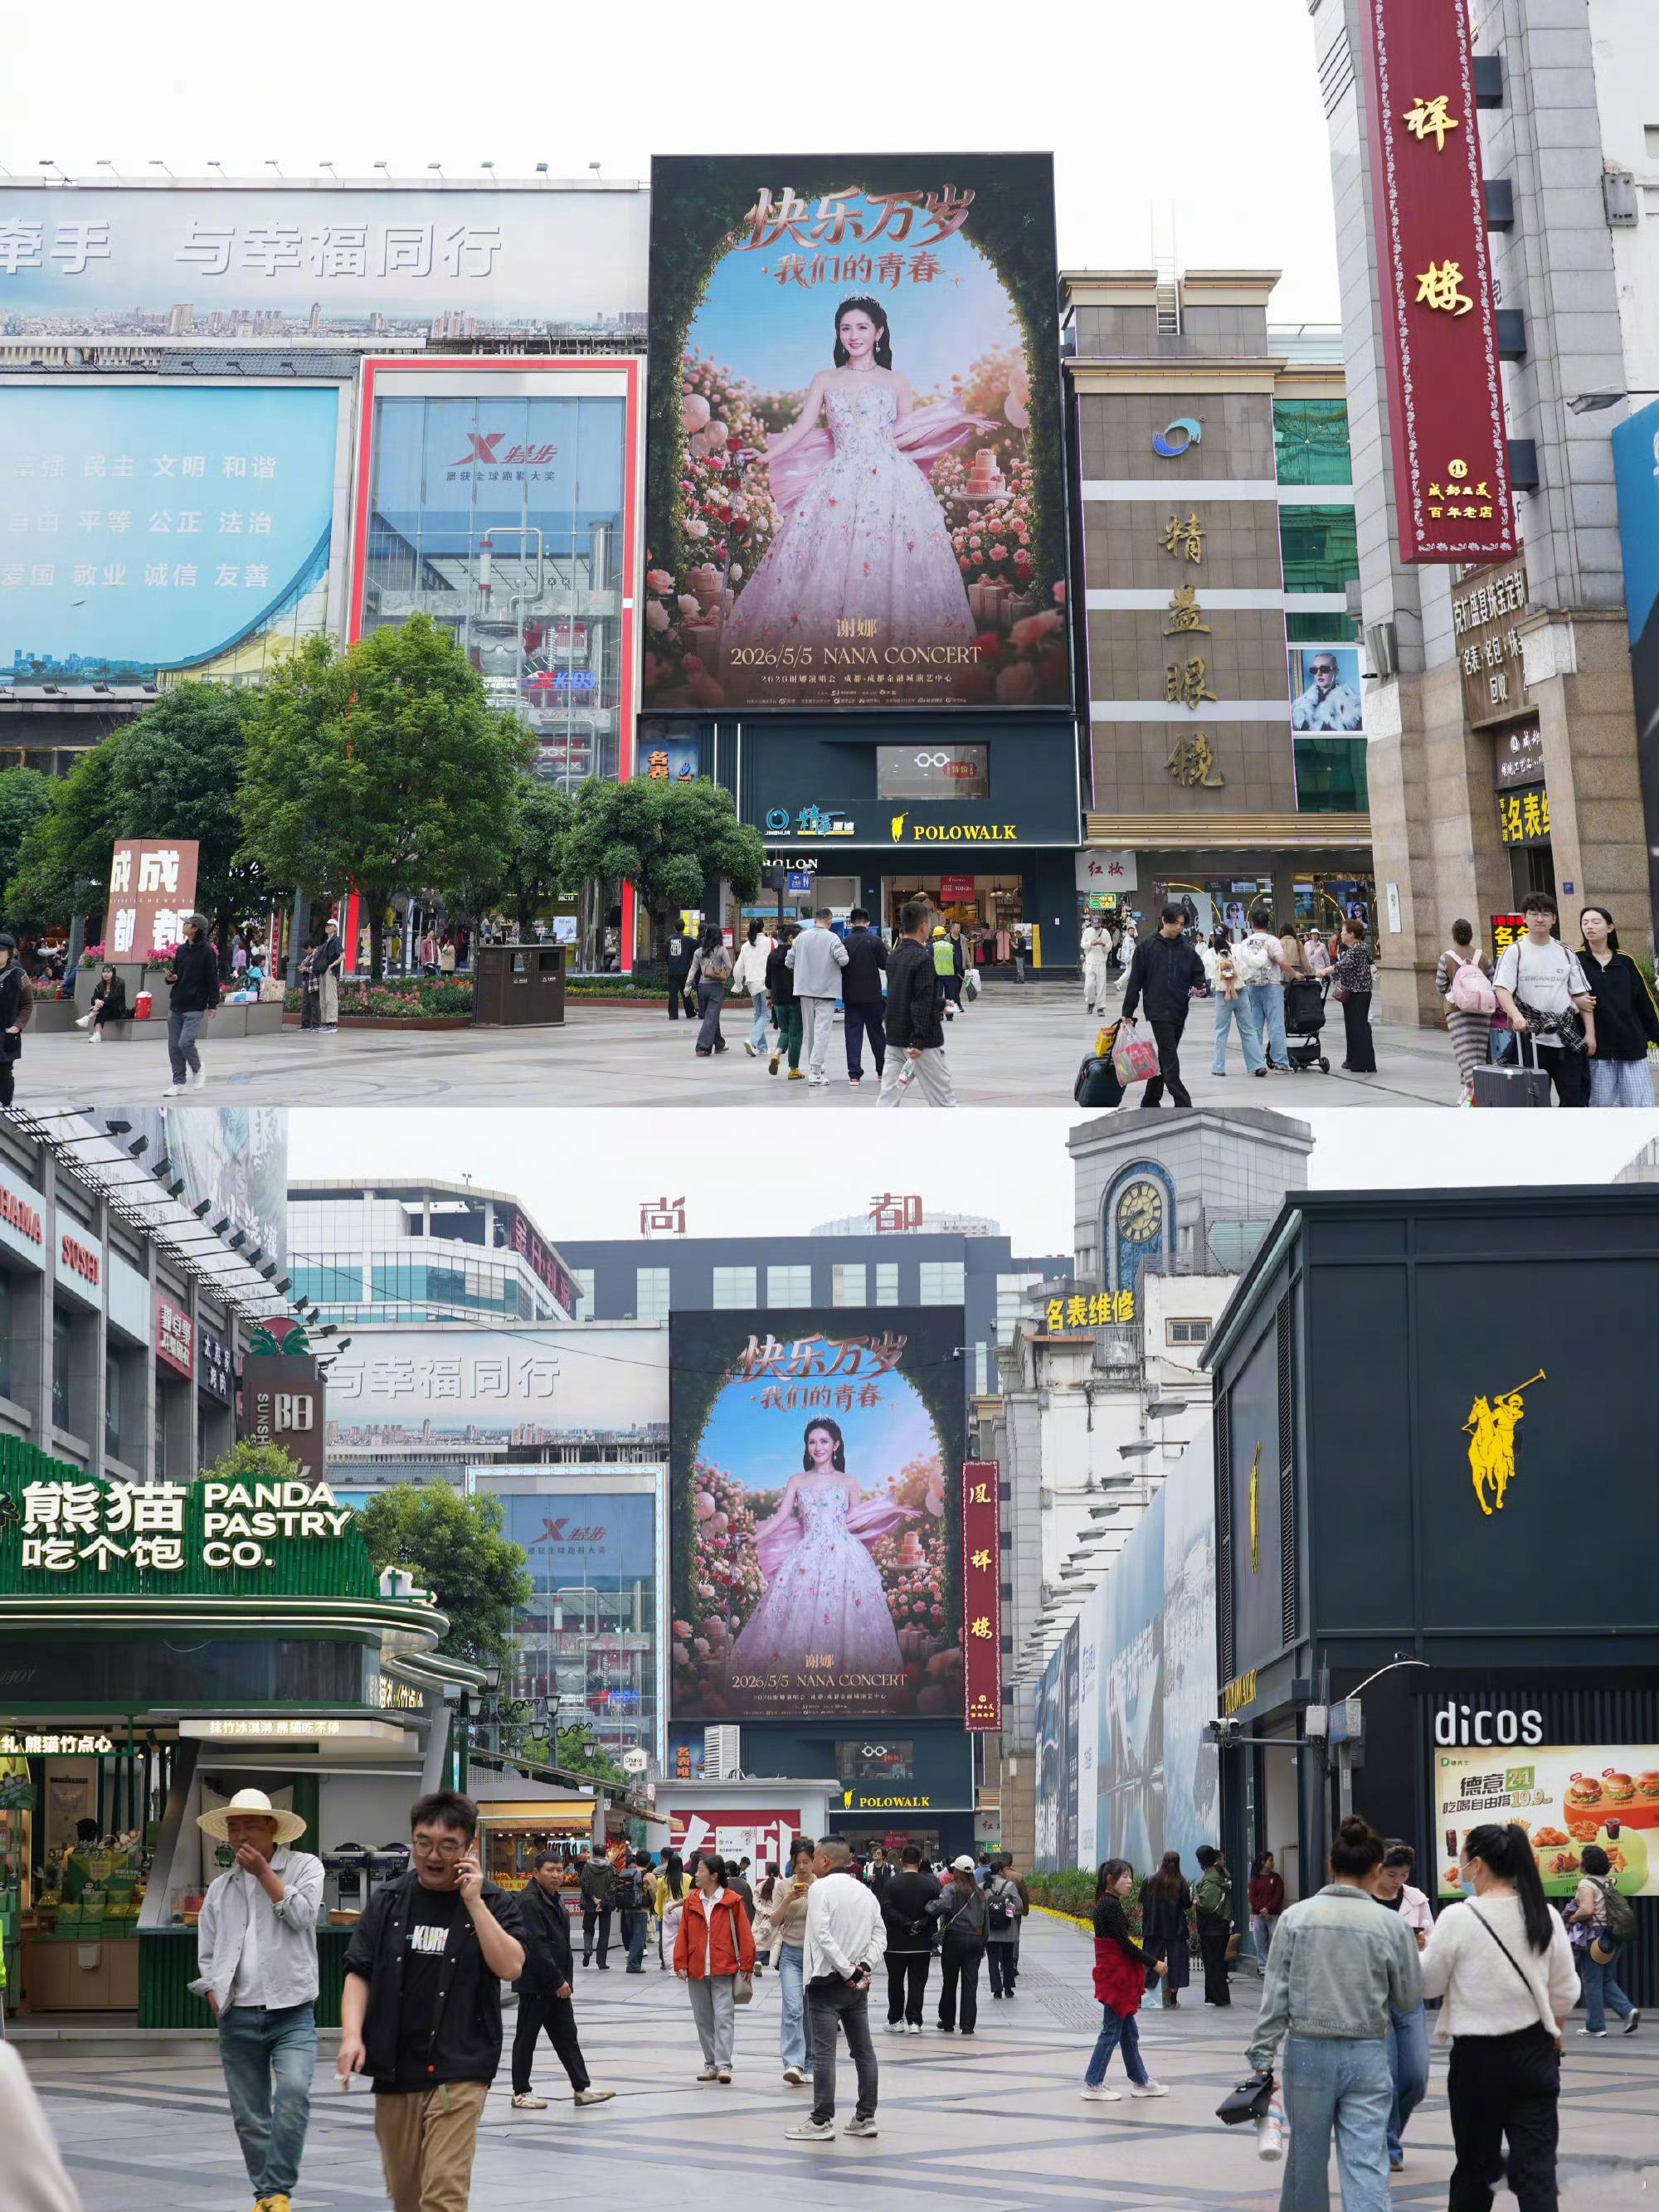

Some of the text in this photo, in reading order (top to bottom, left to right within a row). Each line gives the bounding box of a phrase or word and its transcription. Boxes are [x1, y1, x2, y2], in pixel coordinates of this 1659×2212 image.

[726, 184, 975, 250] 快乐万岁
[0, 219, 502, 277] 牵手 与幸福同行
[499, 444, 558, 464] 特步
[84, 455, 135, 478] 民主
[154, 455, 205, 479] 文明
[223, 455, 276, 479] 和谐
[8, 510, 273, 534] 自由 平等 公正 法治
[1428, 506, 1492, 518] 百年老店
[73, 563, 126, 587] 敬业
[144, 563, 199, 587] 诚信
[214, 563, 269, 588] 友善
[835, 618, 877, 638] 谢娜
[730, 644, 982, 668] 2026/5/5 NANA CONCERT
[1490, 673, 1508, 704] 回收
[913, 825, 1017, 840] POLOWALK
[139, 850, 180, 892] 成
[1087, 861, 1124, 877] 红妆
[62, 1234, 100, 1285] SUSHI
[1045, 1290, 1135, 1331] 名表维修
[727, 1330, 907, 1384] 快乐万岁
[329, 1355, 560, 1400] 与幸福同行
[21, 1480, 187, 1535] 熊猫
[205, 1482, 338, 1509] PANDA
[205, 1511, 354, 1539] PASTRY
[22, 1535, 185, 1572] 吃个饱
[202, 1541, 276, 1568] CO.
[805, 1654, 834, 1669] 谢娜
[732, 1674, 907, 1689] 2026/5/5 NANA CONCERT
[276, 1721, 340, 1734] 熊猫吃不停
[1436, 1702, 1543, 1746] dicos
[25, 1735, 113, 1753] 熊猫竹点心
[1460, 1773, 1506, 1797] 德意
[859, 1796, 930, 1807] POLOWALK
[1443, 1794, 1511, 1814] 吃喝自由搭
